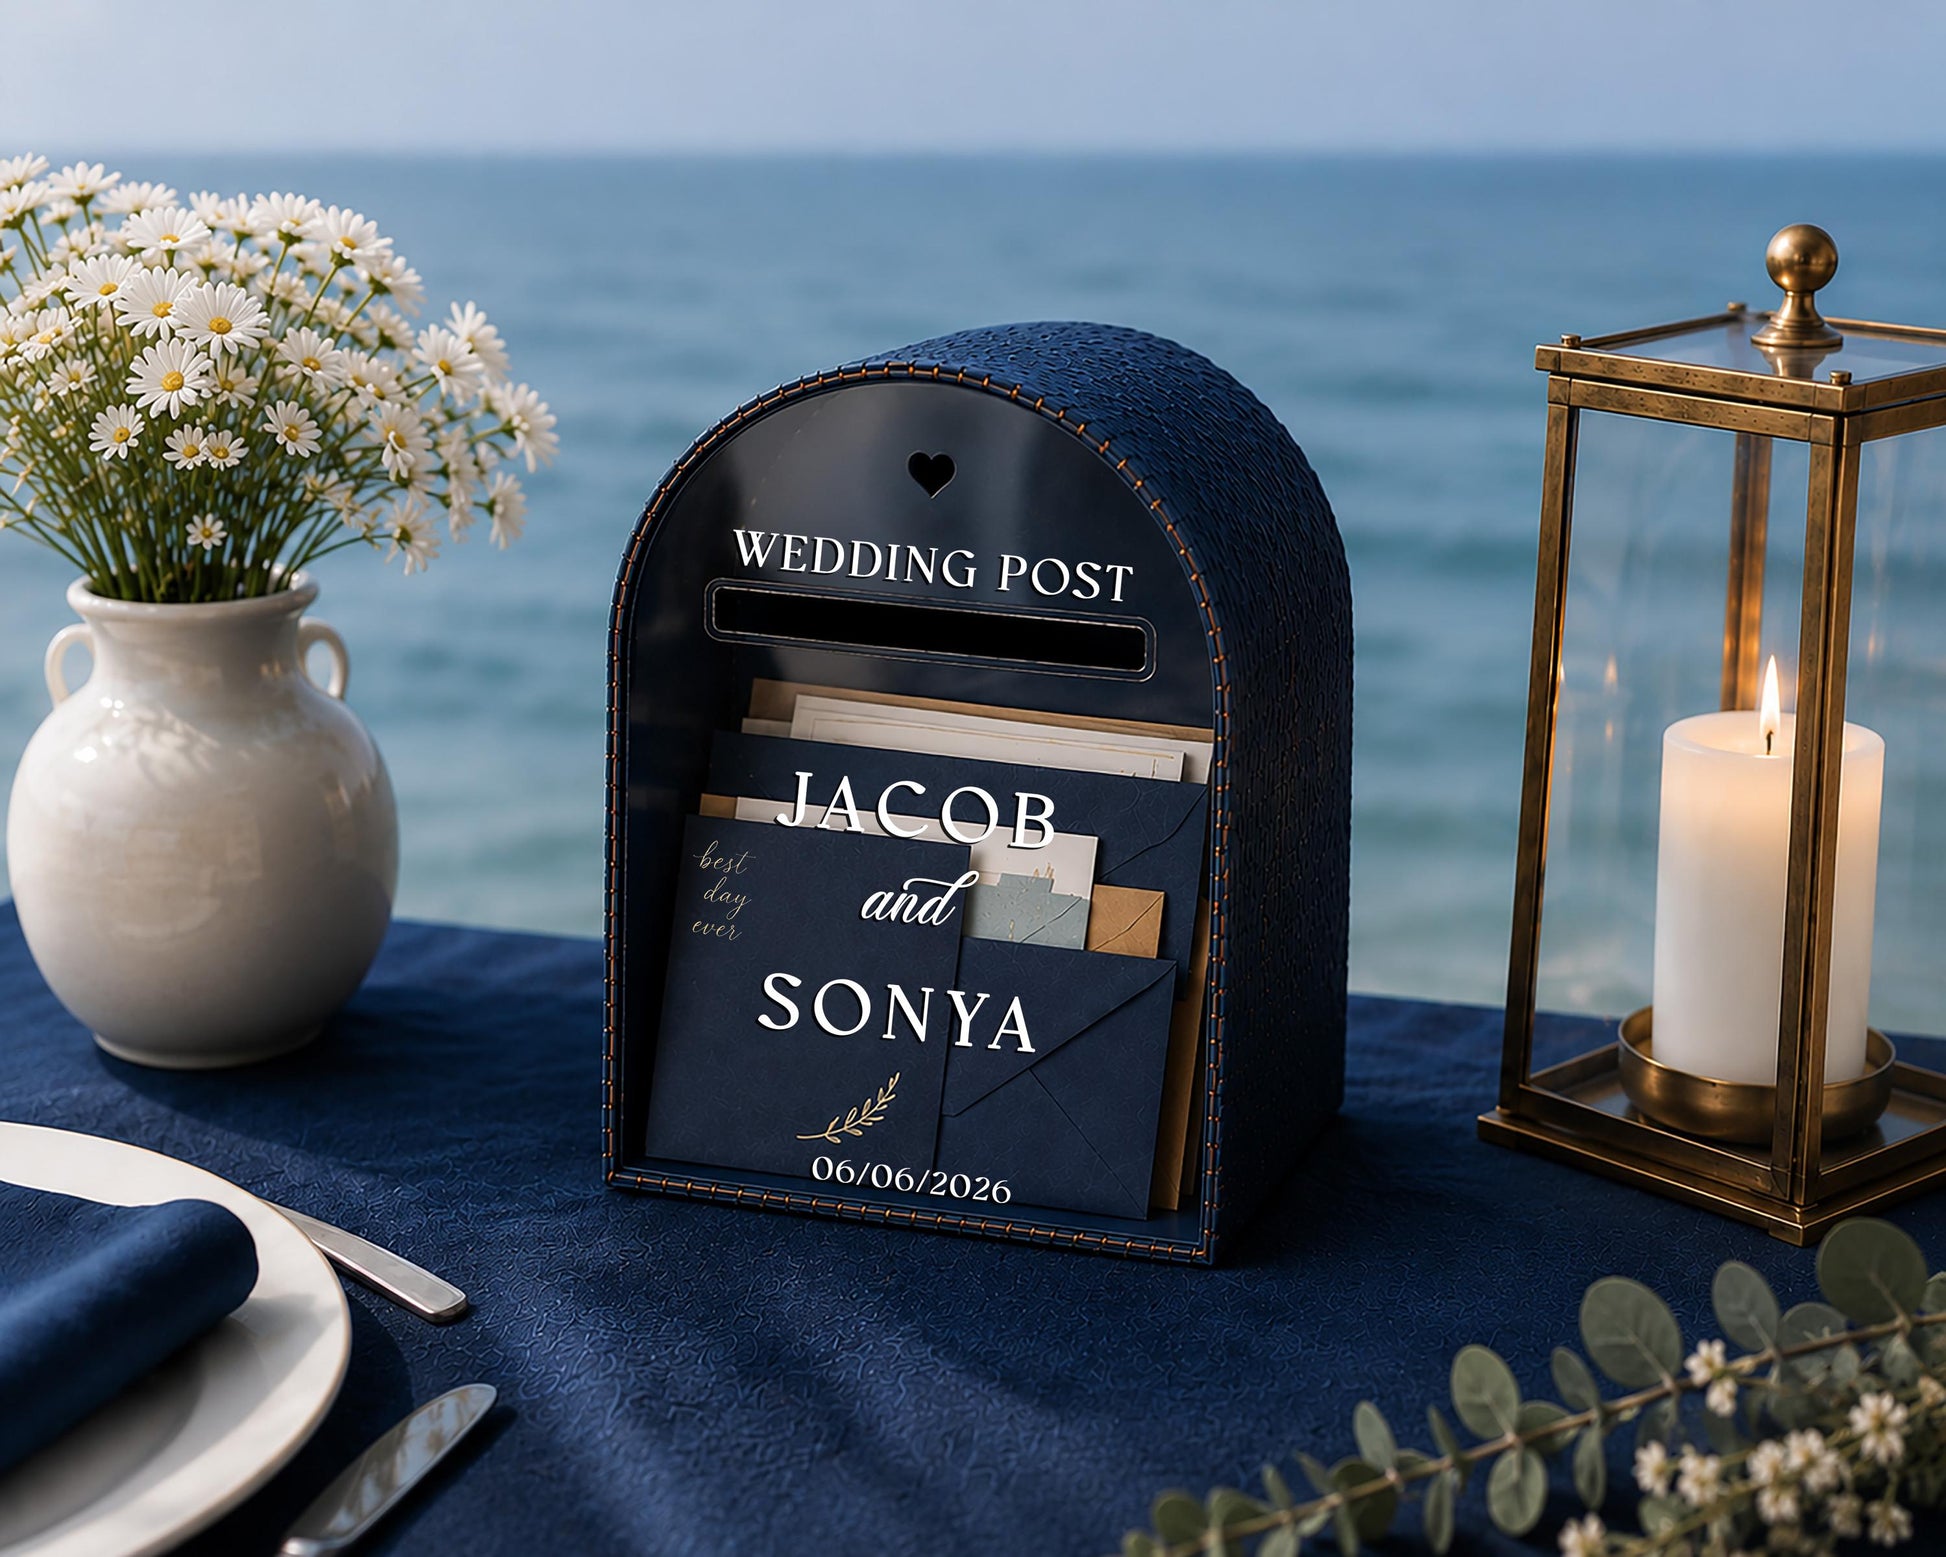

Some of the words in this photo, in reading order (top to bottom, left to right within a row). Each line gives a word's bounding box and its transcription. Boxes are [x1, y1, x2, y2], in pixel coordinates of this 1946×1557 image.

[733, 529, 976, 587] WEDDING
[998, 554, 1133, 601] POST
[776, 771, 1055, 848] JACOB
[693, 840, 756, 874] best
[703, 876, 751, 920] day
[861, 870, 979, 926] and
[692, 919, 742, 941] ever
[757, 972, 1036, 1053] SONYA
[812, 1156, 1011, 1204] 06/06/2026
